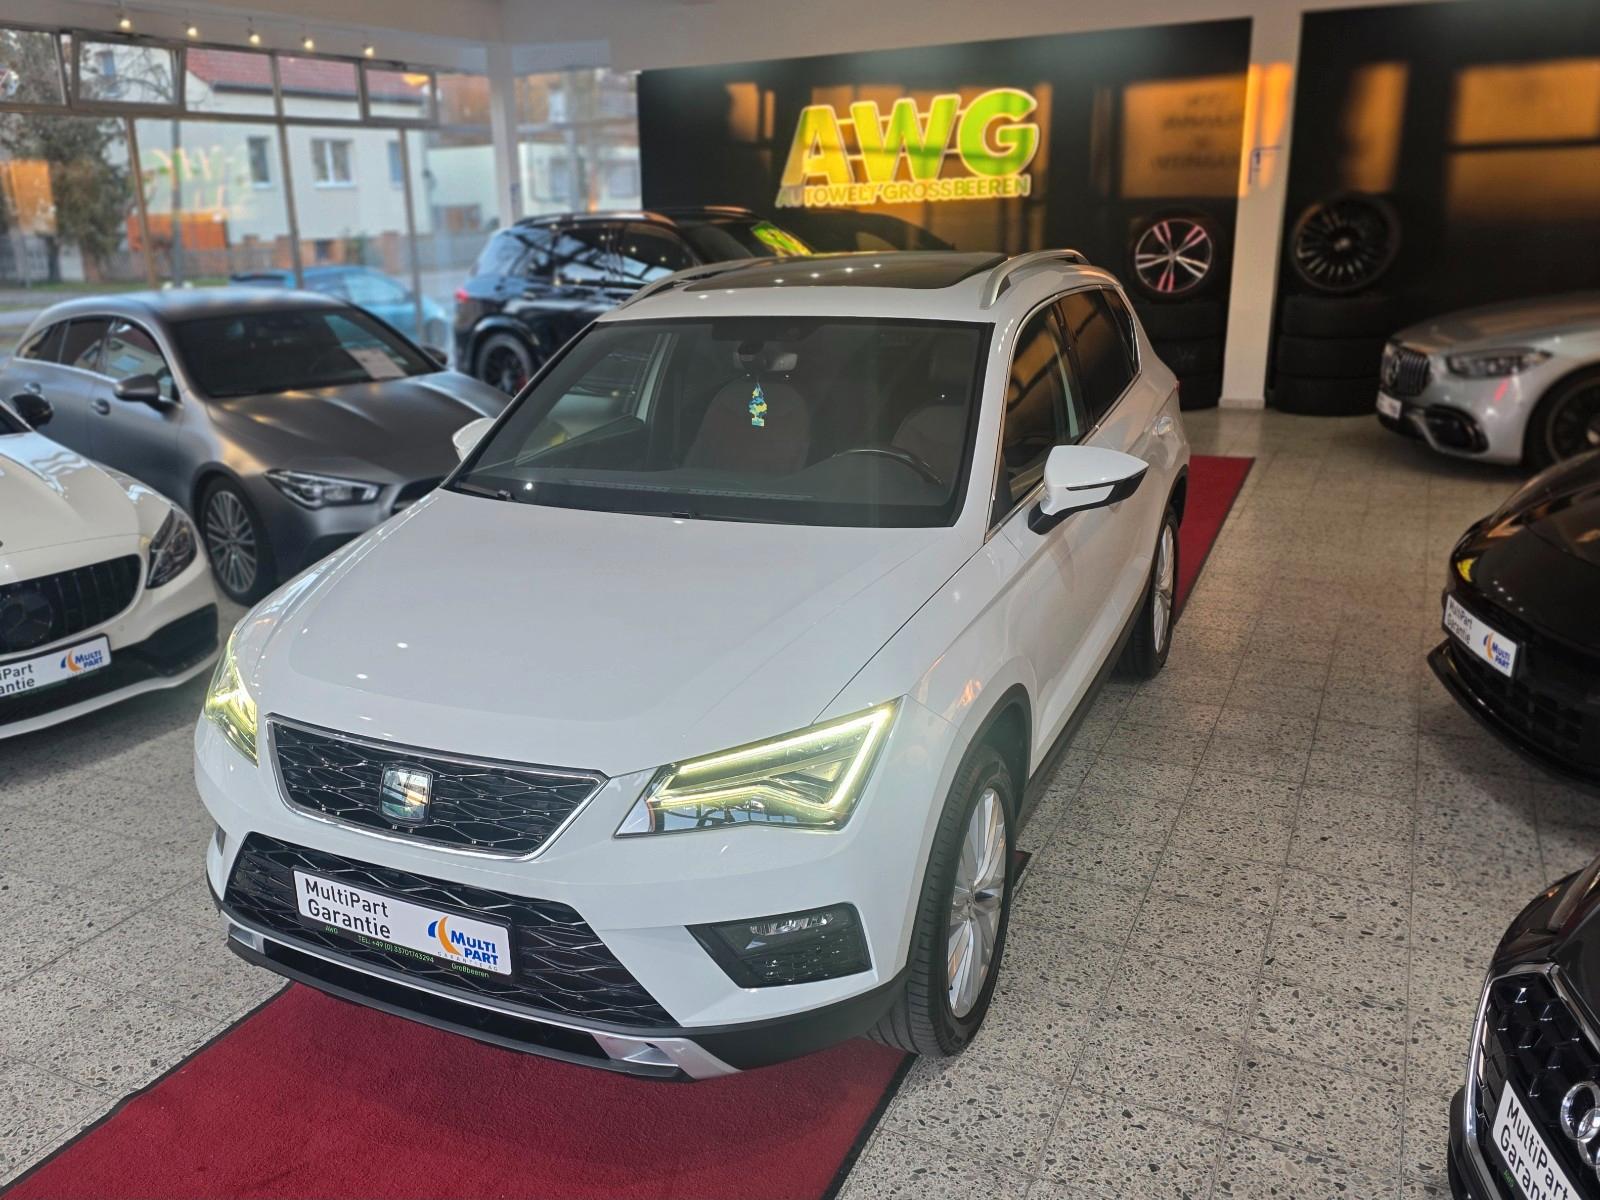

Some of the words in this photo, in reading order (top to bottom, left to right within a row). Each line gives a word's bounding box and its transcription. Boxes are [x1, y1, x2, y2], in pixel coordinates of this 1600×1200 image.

[781, 87, 1039, 186] AWG
[881, 176, 1031, 202] GROSSBEEREN
[83, 656, 104, 669] PART
[304, 877, 389, 918] MultiPart
[308, 897, 391, 939] Garantie
[464, 947, 499, 966] PART
